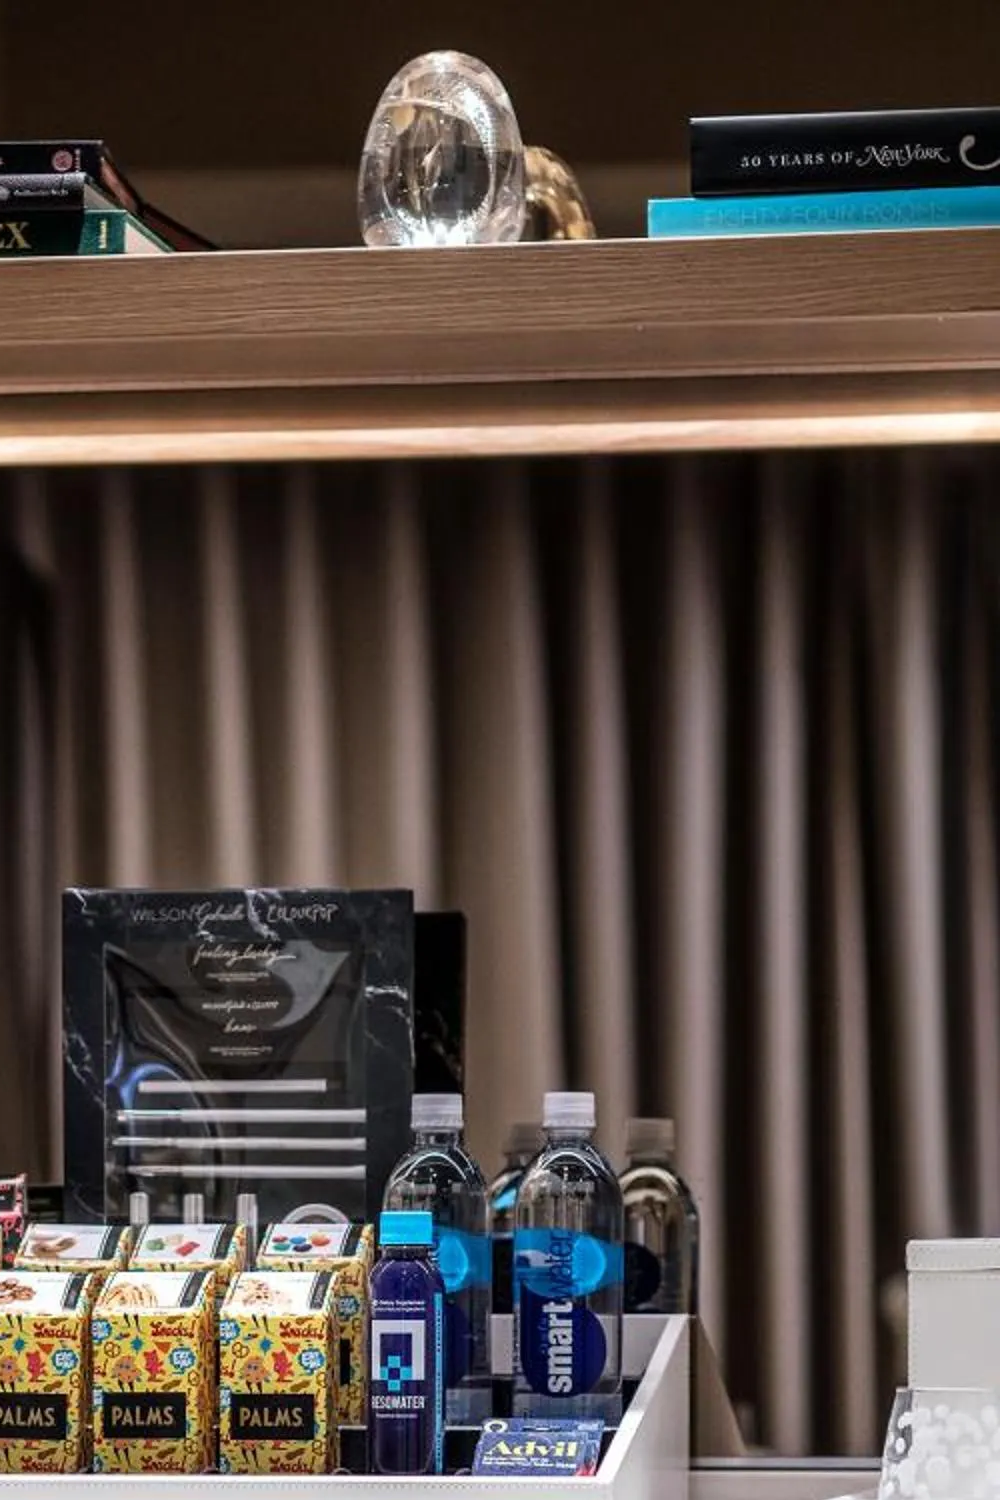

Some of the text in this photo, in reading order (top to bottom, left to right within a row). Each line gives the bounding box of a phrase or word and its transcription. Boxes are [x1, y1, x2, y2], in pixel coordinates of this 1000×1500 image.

[740, 156, 762, 168] 50
[768, 153, 825, 167] YEARS
[831, 152, 853, 165] OF
[111, 1404, 175, 1427] PALMS
[239, 1406, 304, 1428] PALMS
[483, 1440, 578, 1457] Advil
